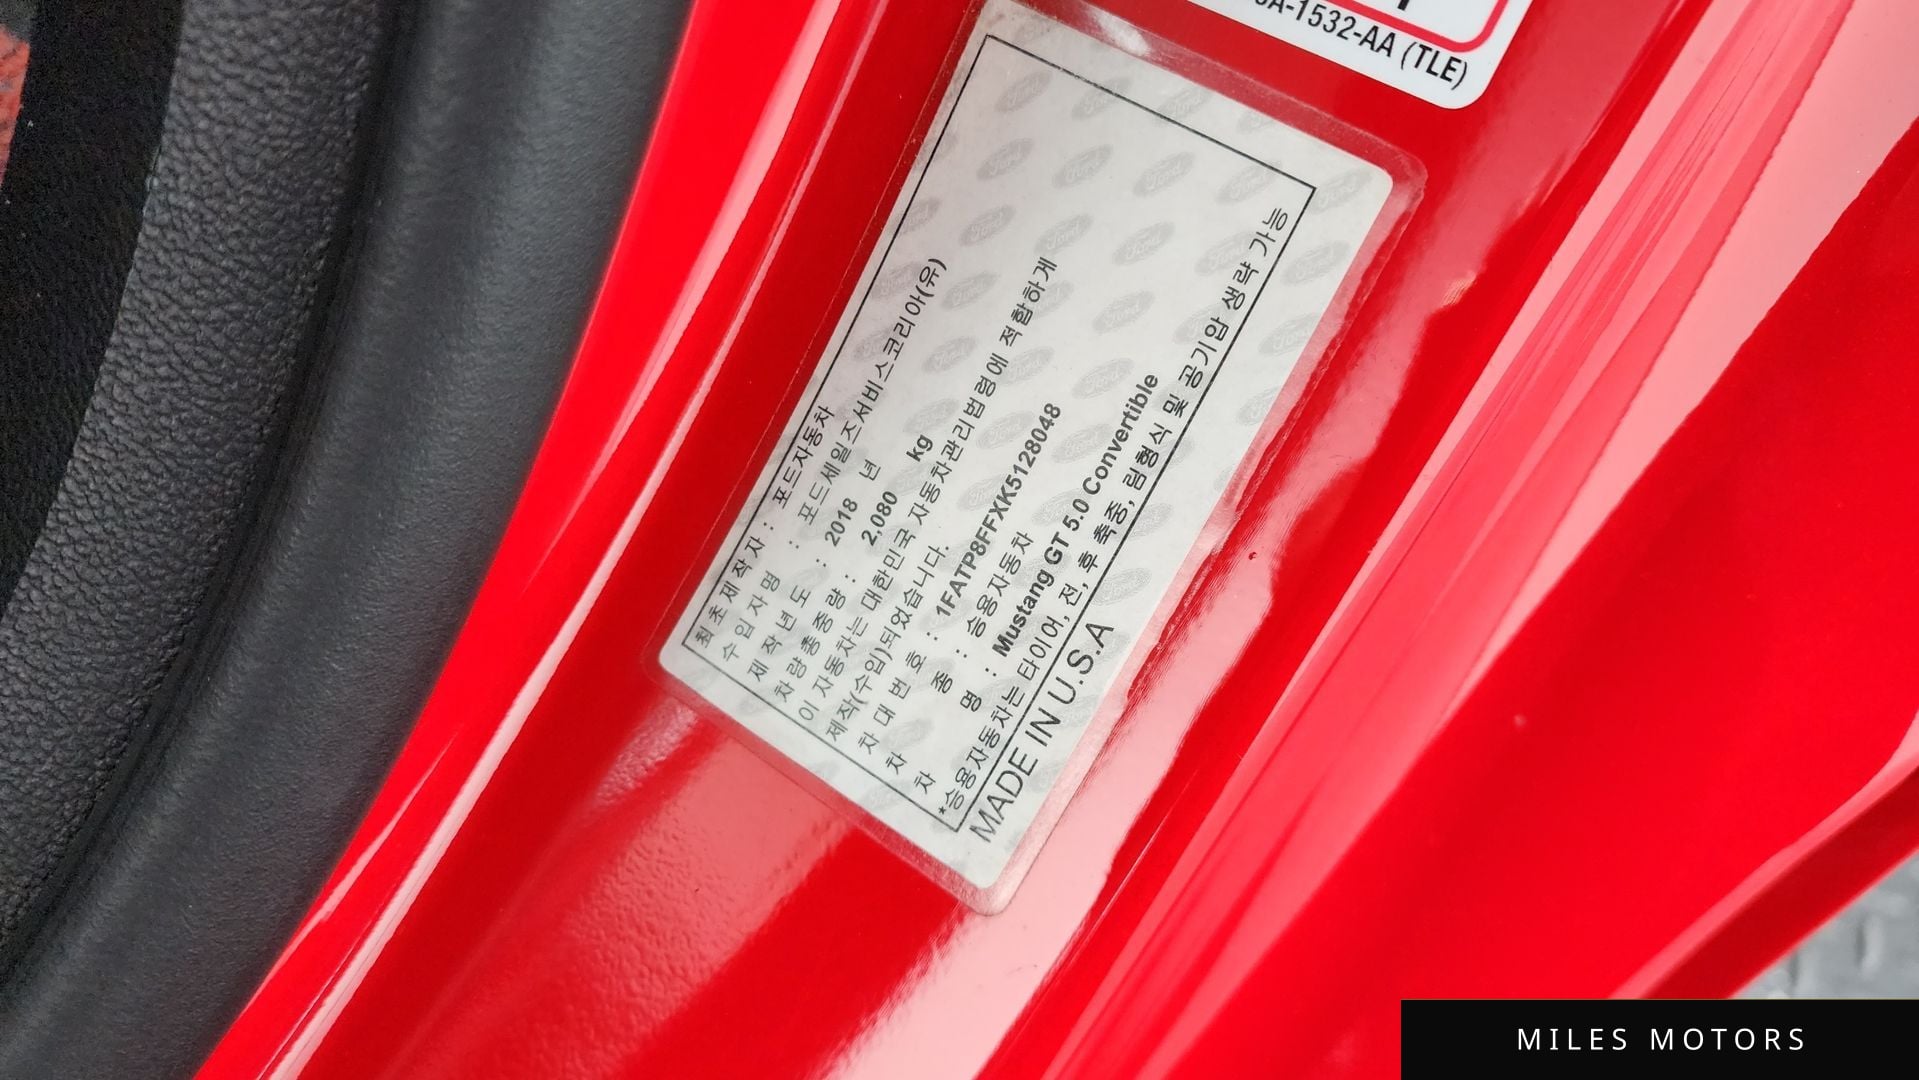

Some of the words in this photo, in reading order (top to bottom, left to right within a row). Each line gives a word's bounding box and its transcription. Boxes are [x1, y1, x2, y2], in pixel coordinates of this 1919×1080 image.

[1401, 41, 1468, 90] (TLE)
[770, 404, 835, 510] 포드자동차
[796, 257, 947, 526] 포드세일즈서비스코리아(유)
[797, 699, 820, 721] 이
[811, 615, 869, 698] 자동차는
[859, 527, 917, 612] 대한민국
[906, 351, 1009, 526] 자동차관리법령에
[997, 255, 1058, 347] 적합하게
[860, 489, 898, 547] 2,080
[904, 433, 934, 463] kg
[1015, 614, 1071, 681] 타이어,
[1057, 581, 1089, 607] 전,
[1076, 549, 1099, 574] 후
[1092, 498, 1136, 545] 축중,
[1121, 421, 1173, 491] 림형식
[1161, 392, 1189, 419] 및
[1176, 315, 1230, 389] 공기압
[1220, 260, 1260, 311] 생략
[1247, 206, 1289, 258] 가능
[823, 496, 858, 548] 2018
[857, 457, 882, 481] 년
[934, 401, 1061, 617] 1FATP8FFXK5128048
[965, 530, 1034, 639] 승용자동차
[990, 567, 1055, 658] Mustang
[1042, 530, 1070, 566] GT
[1061, 497, 1090, 532] 5.0
[1081, 373, 1159, 496] Convertible
[824, 544, 950, 742] 제작(수입)되었습니다.
[968, 745, 1039, 843] MADE
[1023, 705, 1062, 747] IN
[1046, 621, 1115, 705] U.S.A
